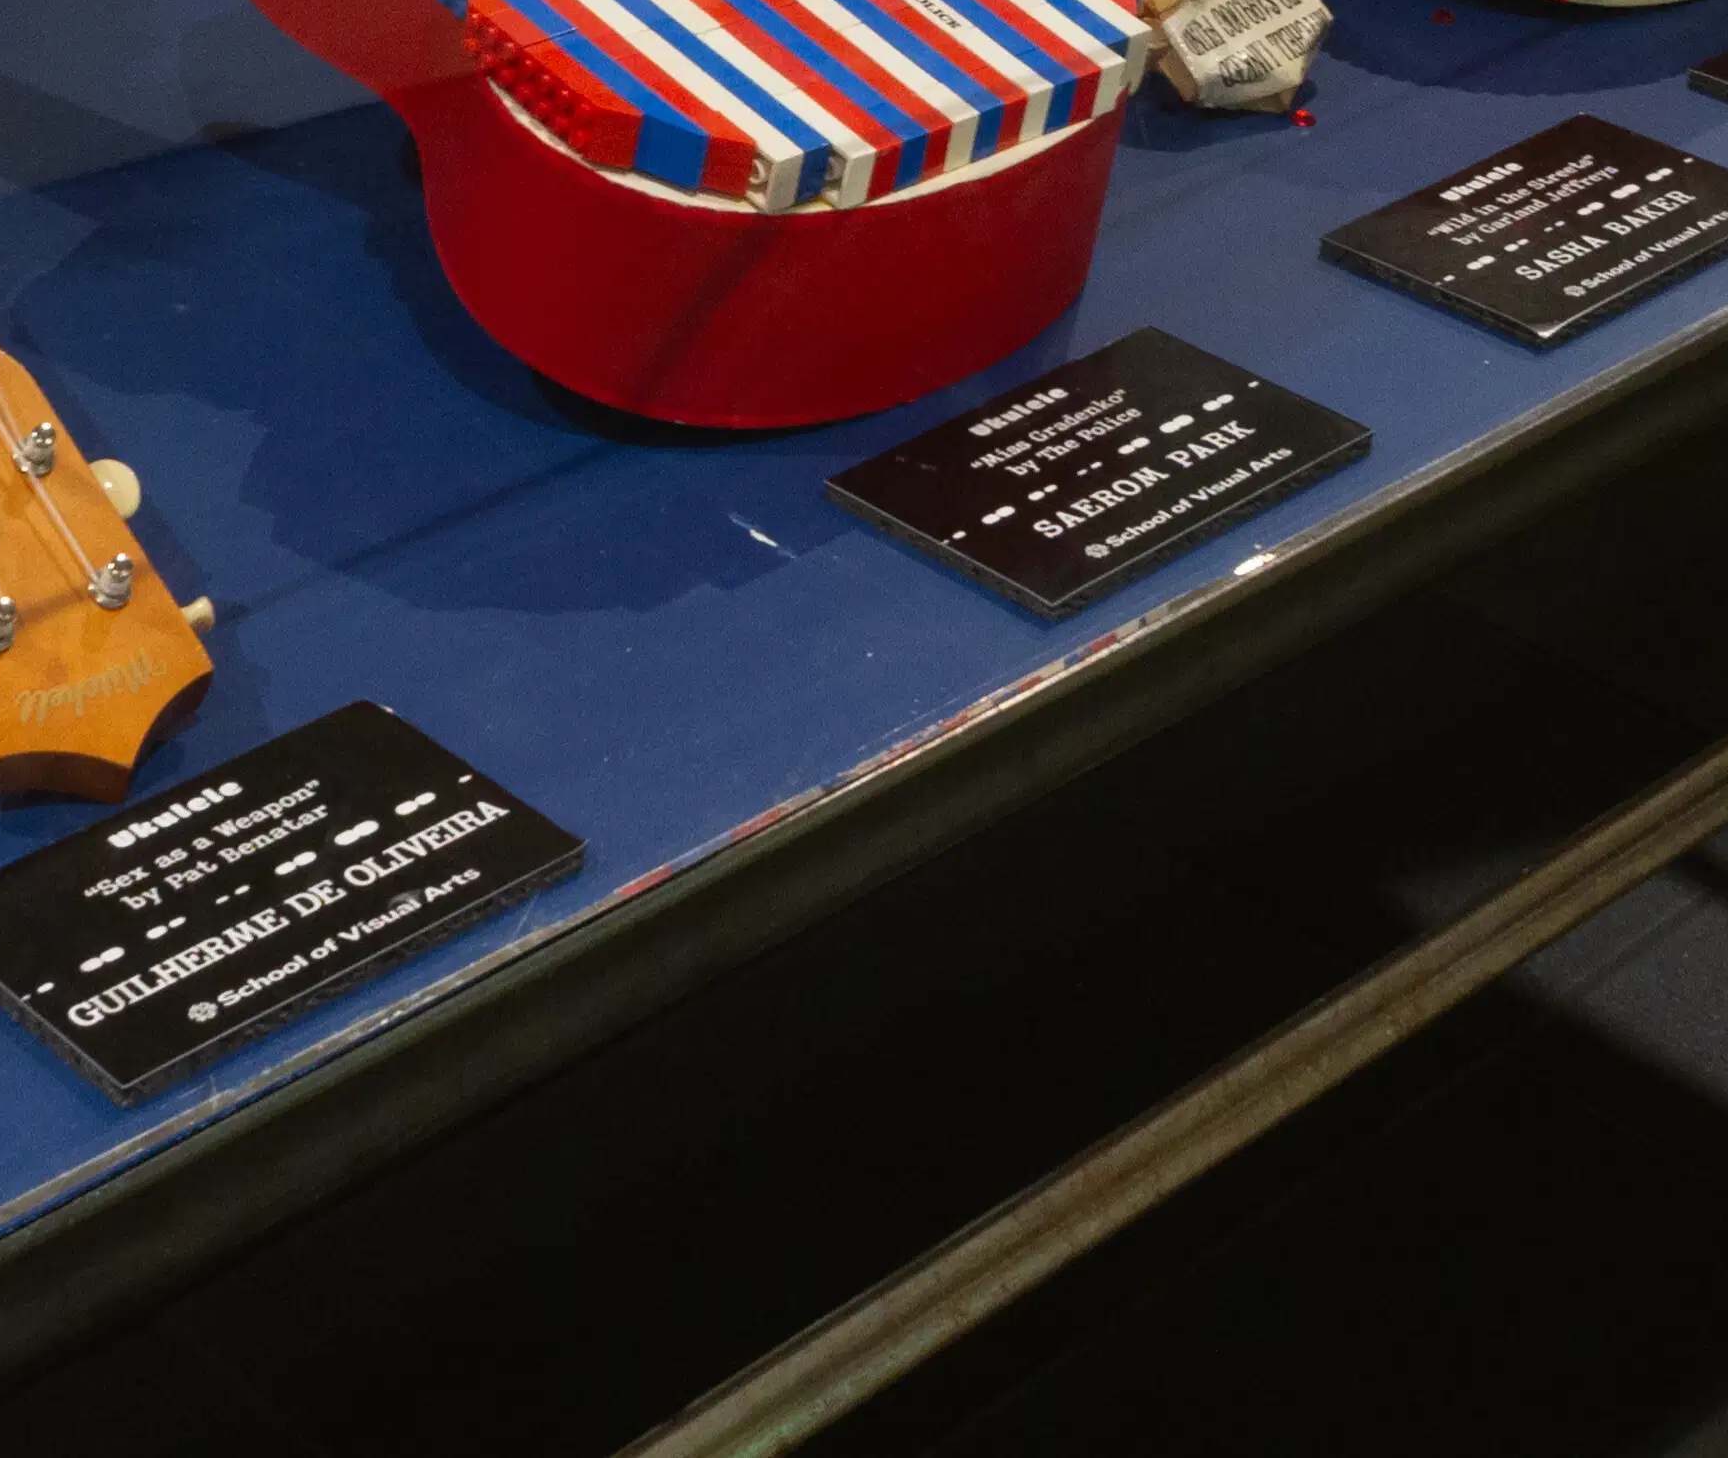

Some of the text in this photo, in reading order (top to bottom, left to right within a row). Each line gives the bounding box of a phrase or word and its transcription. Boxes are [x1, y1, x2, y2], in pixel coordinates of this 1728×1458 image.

[1427, 213, 1478, 235] “Wild
[1472, 204, 1500, 216] in
[1496, 188, 1532, 204] the
[1439, 163, 1523, 201] Ukulele
[1451, 166, 1619, 245] by Garland Jeffreys
[1515, 191, 1696, 280] SASHA BAKER
[1580, 259, 1636, 288] School
[1634, 250, 1653, 262] of
[1648, 226, 1701, 252] Visual
[968, 388, 1069, 436] Ukulele
[1005, 408, 1142, 476] by The Police
[971, 441, 1032, 468] “Miss
[1033, 420, 1255, 538] SAEROM PARK
[1105, 448, 1292, 547] School of Visual Arts
[84, 780, 319, 897] “Sex as a Weapon”
[107, 782, 243, 848] Ukulele
[120, 805, 328, 910] by Pat Benatar
[68, 801, 509, 1026] GUILHERME DE OLIVEIRA
[217, 869, 481, 1007] School of Visual Arts
